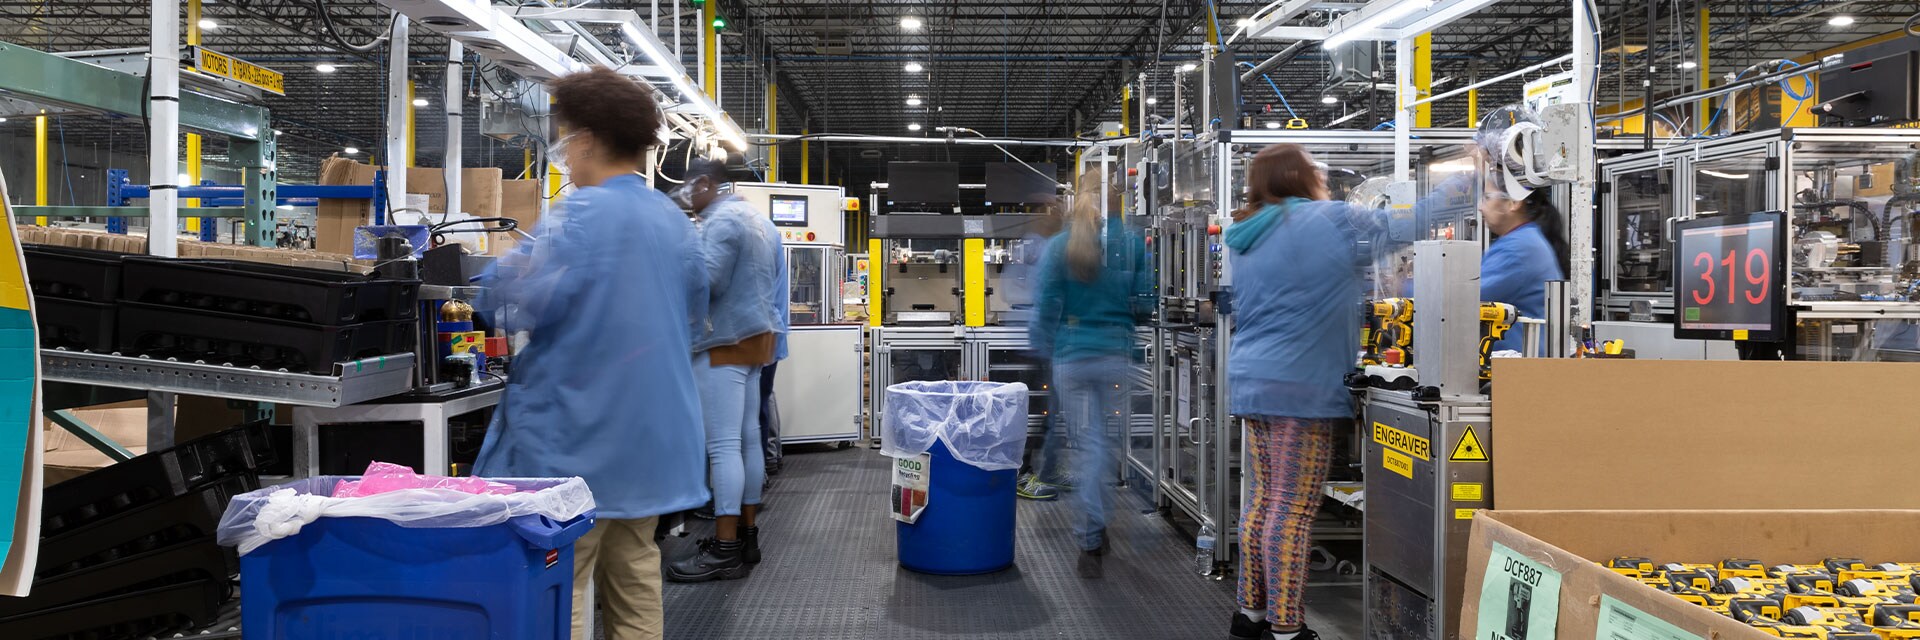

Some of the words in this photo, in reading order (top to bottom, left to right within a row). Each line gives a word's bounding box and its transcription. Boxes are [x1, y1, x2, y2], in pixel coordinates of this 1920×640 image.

[201, 52, 227, 74] MOTORS
[1692, 248, 1769, 305] 319
[1375, 425, 1428, 458] ENGRAVER
[899, 458, 921, 471] GOOD
[1504, 556, 1543, 587] DCF887
